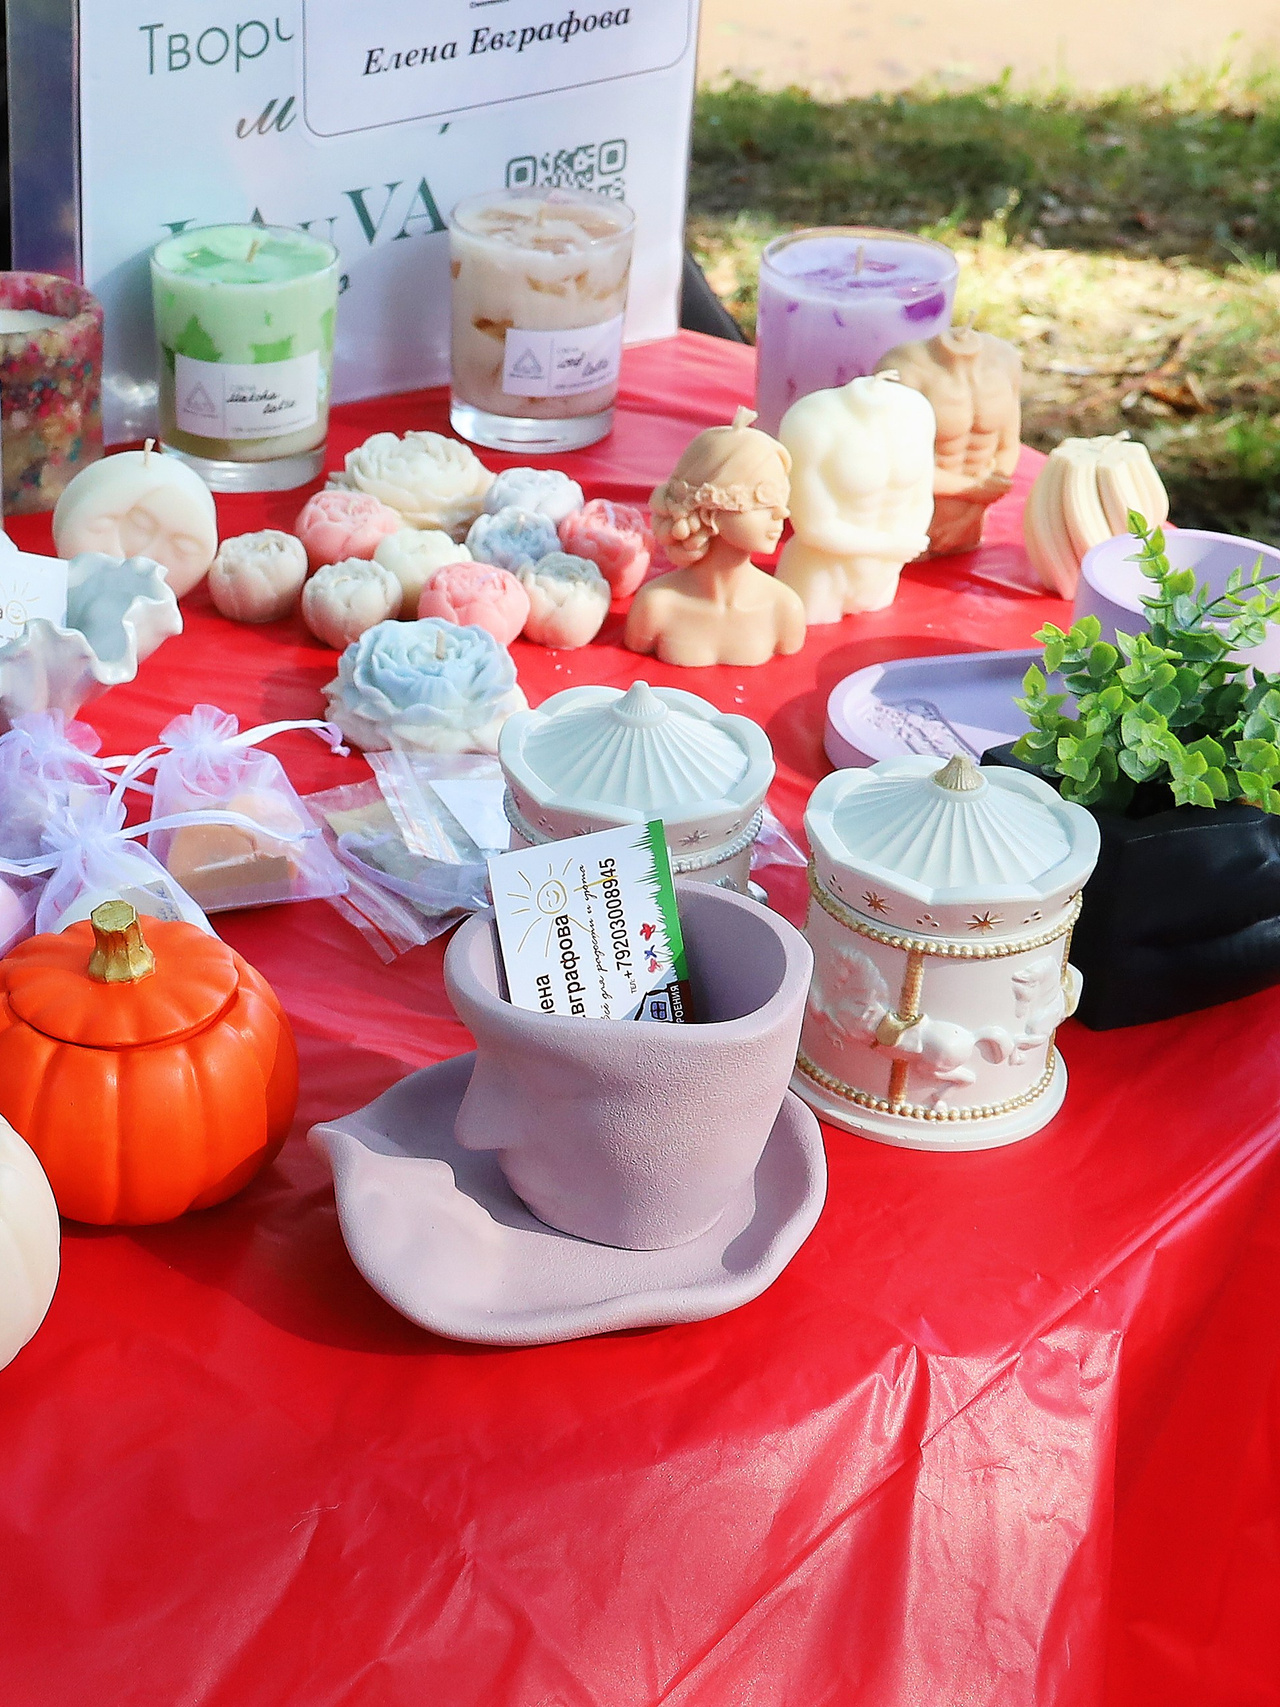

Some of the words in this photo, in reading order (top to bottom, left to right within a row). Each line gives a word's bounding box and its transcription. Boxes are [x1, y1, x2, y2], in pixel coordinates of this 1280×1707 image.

[362, 42, 458, 77] Елена
[469, 7, 631, 56] Евграфова
[588, 918, 608, 973] радости
[599, 858, 633, 980] +79203008945
[536, 974, 555, 1014] ена
[555, 914, 587, 1018] вграфова
[598, 975, 613, 1000] для
